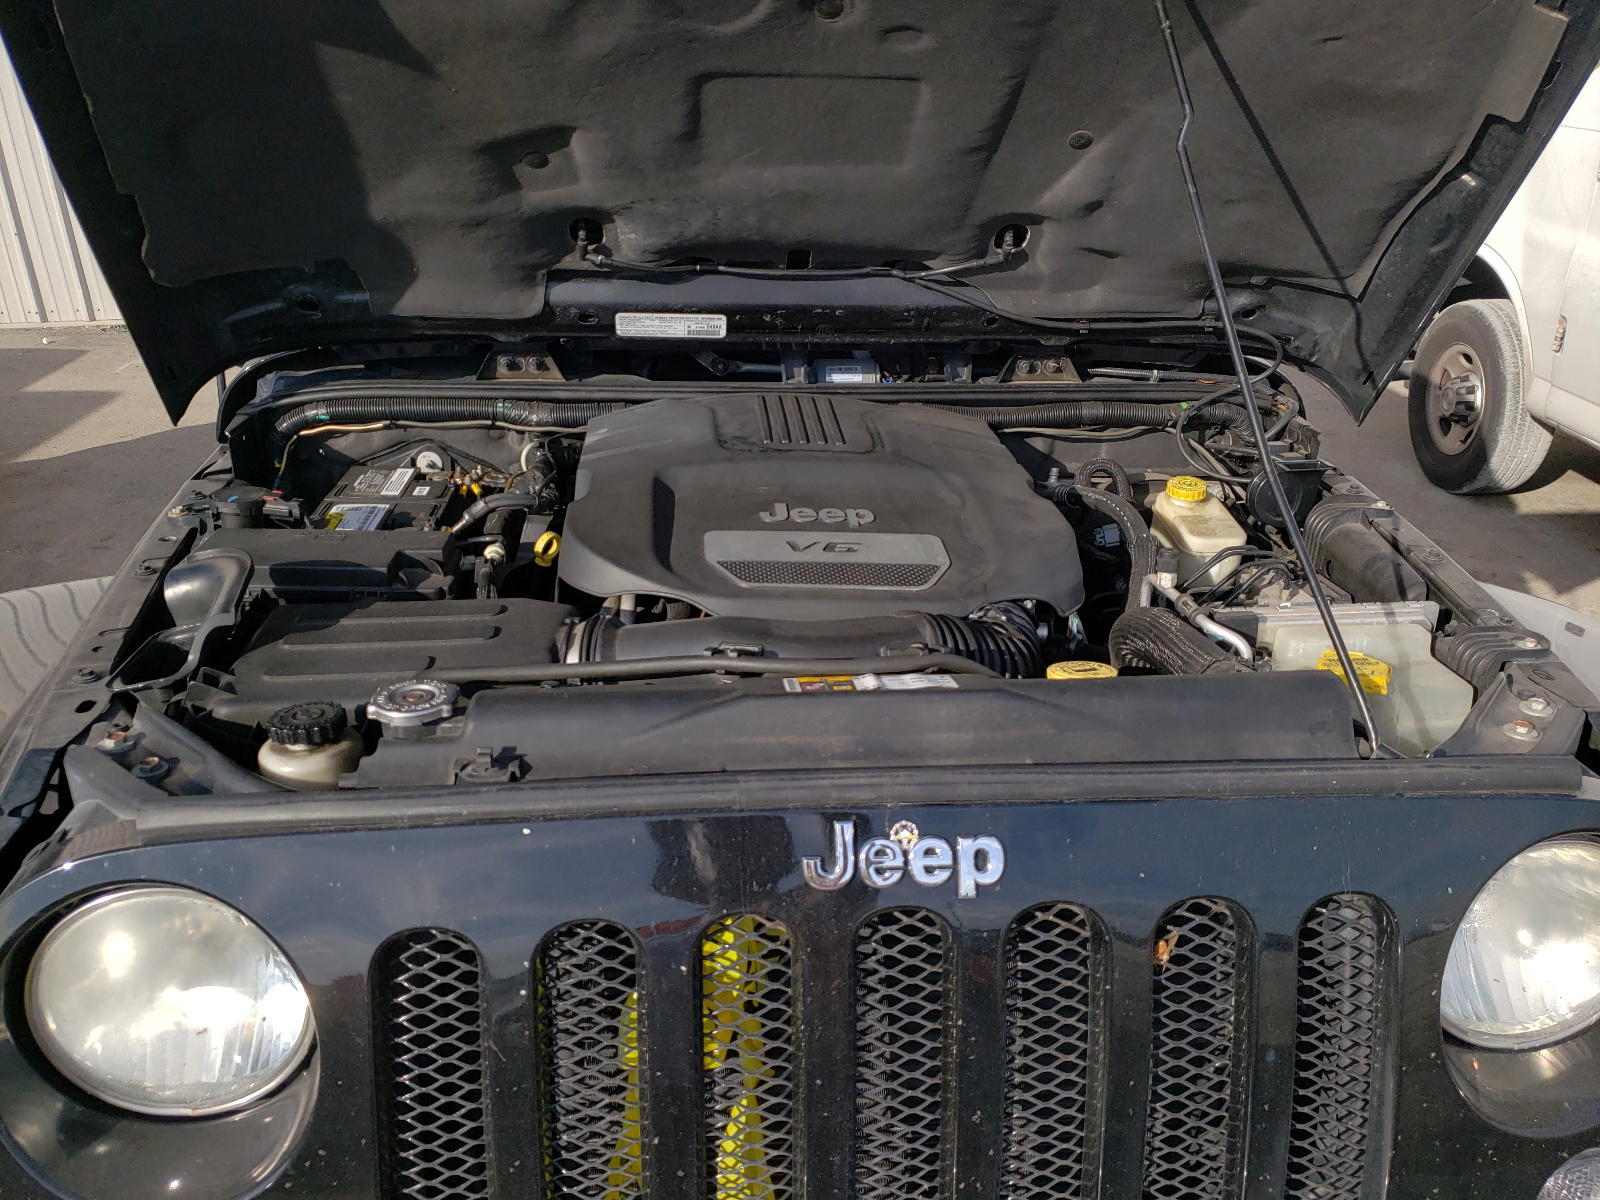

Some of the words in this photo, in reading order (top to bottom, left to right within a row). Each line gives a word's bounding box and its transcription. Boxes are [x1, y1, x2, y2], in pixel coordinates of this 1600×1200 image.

[759, 502, 876, 528] Jeep
[785, 540, 863, 553] V6
[801, 820, 1006, 899] Jeep
